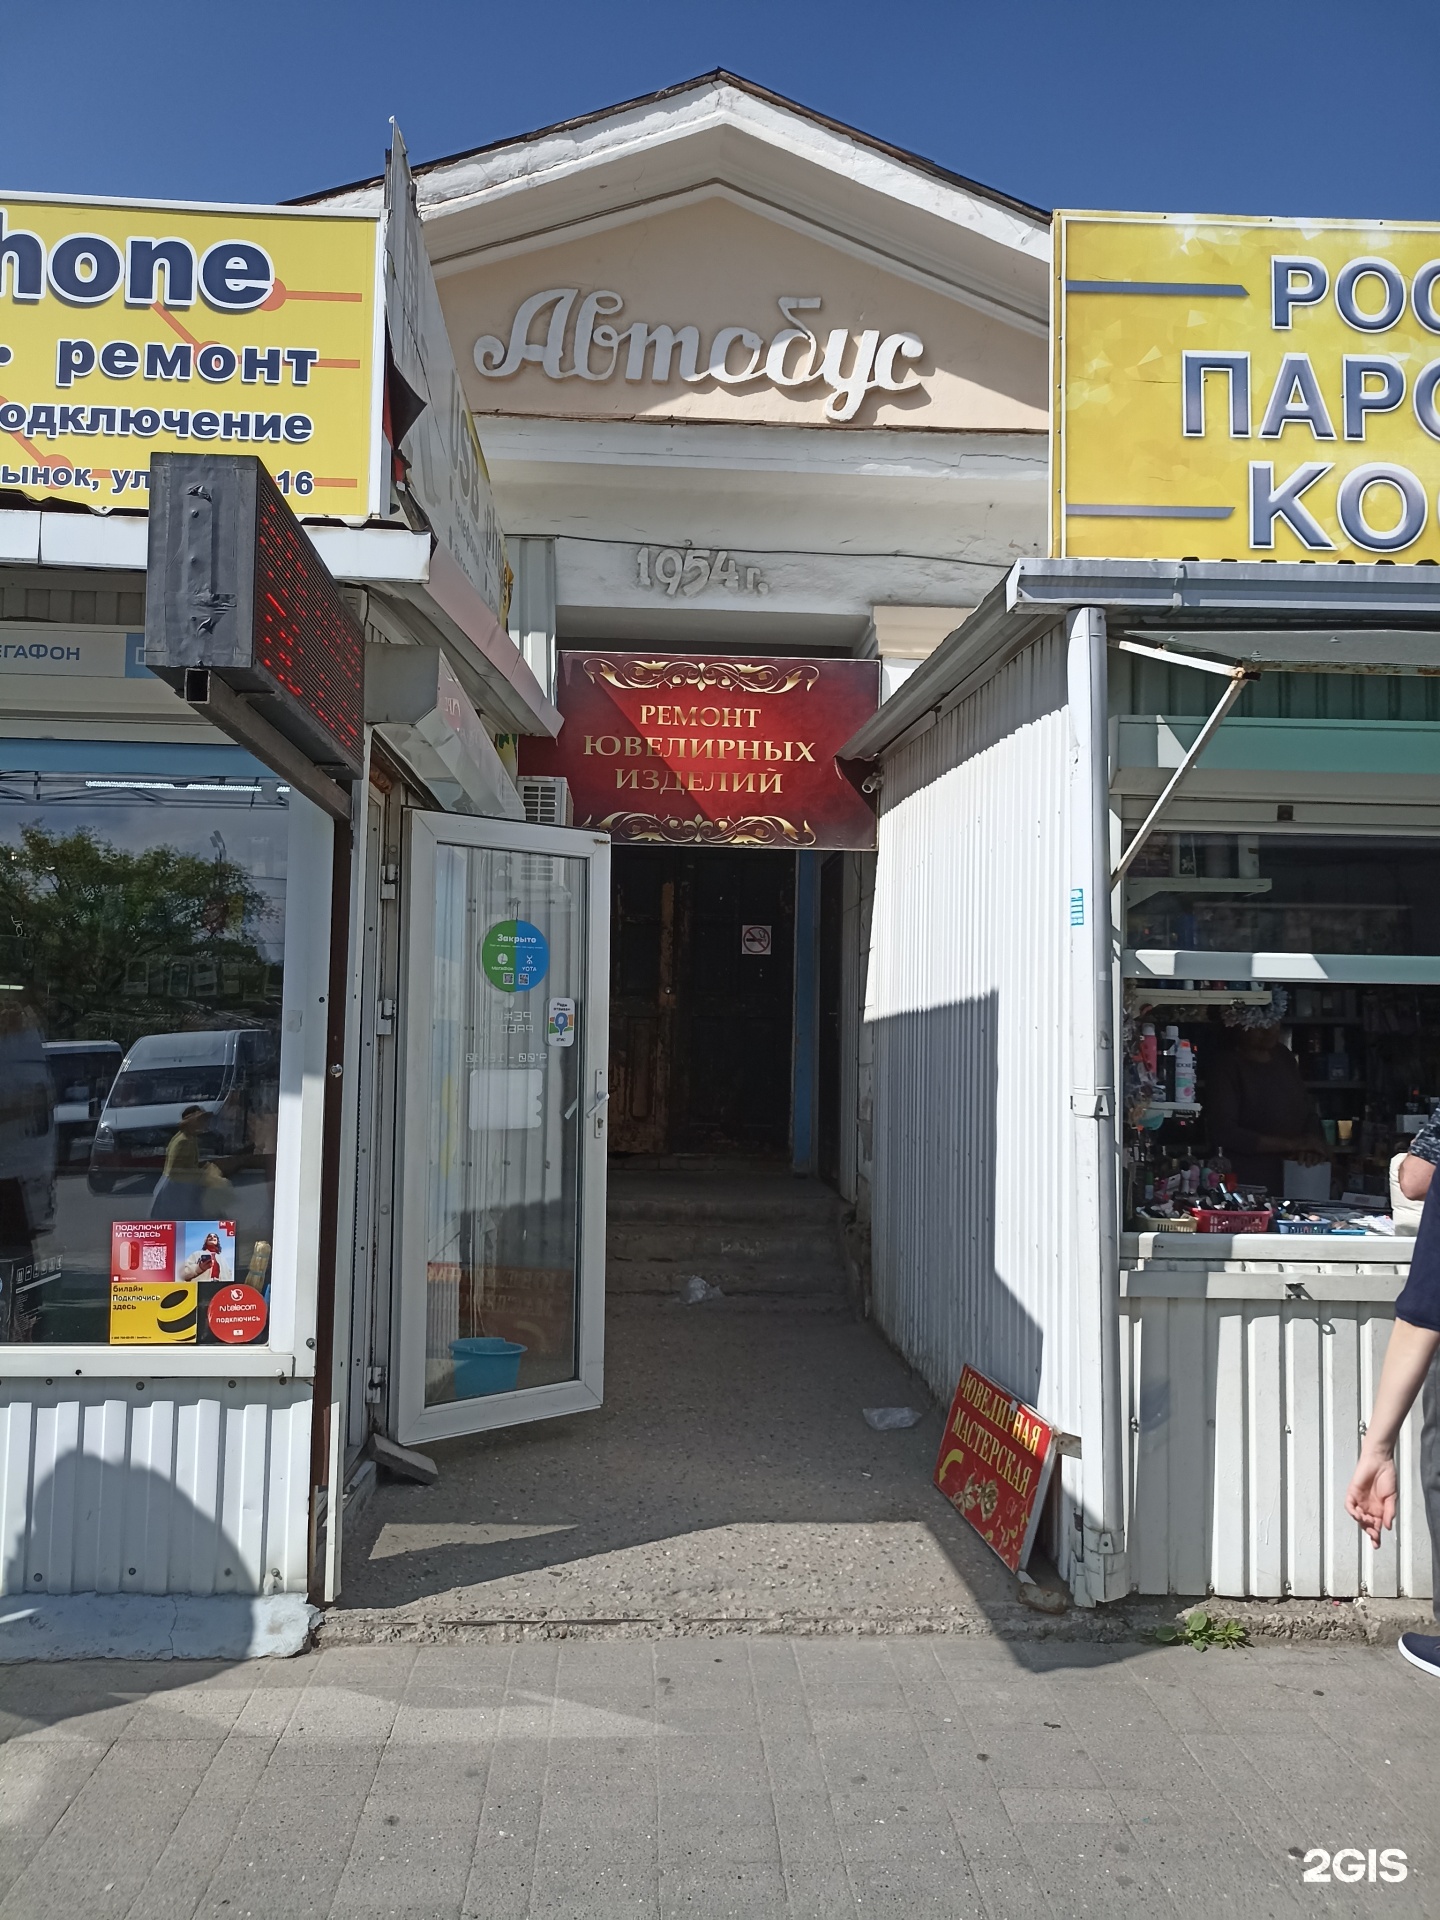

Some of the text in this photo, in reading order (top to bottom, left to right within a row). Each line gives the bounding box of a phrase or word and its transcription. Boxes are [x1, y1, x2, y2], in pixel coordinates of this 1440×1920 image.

[57, 338, 319, 387] ремонт
[474, 288, 924, 422] Автобус
[0, 401, 313, 443] одключение
[450, 369, 480, 524] USB
[276, 469, 315, 496] 16
[1249, 460, 1440, 553] КО
[0, 643, 80, 661] ГАФОН
[639, 704, 762, 728] РЕМОНТ
[583, 734, 816, 762] ЮВЕЛИРНЫХ
[614, 766, 784, 795] ИЗДЕЛИЙ
[497, 933, 537, 944] Закрыто
[115, 1223, 173, 1232] ПОДКЛЮЧИТЕ
[133, 1231, 161, 1239] ЗДЕСЬ
[112, 1294, 161, 1302] Подключись
[216, 1315, 261, 1323] подключись
[961, 1372, 1041, 1457] ЮВЕЛИРНАЯ
[951, 1406, 1033, 1499] МАСТЕРСКАЯ
